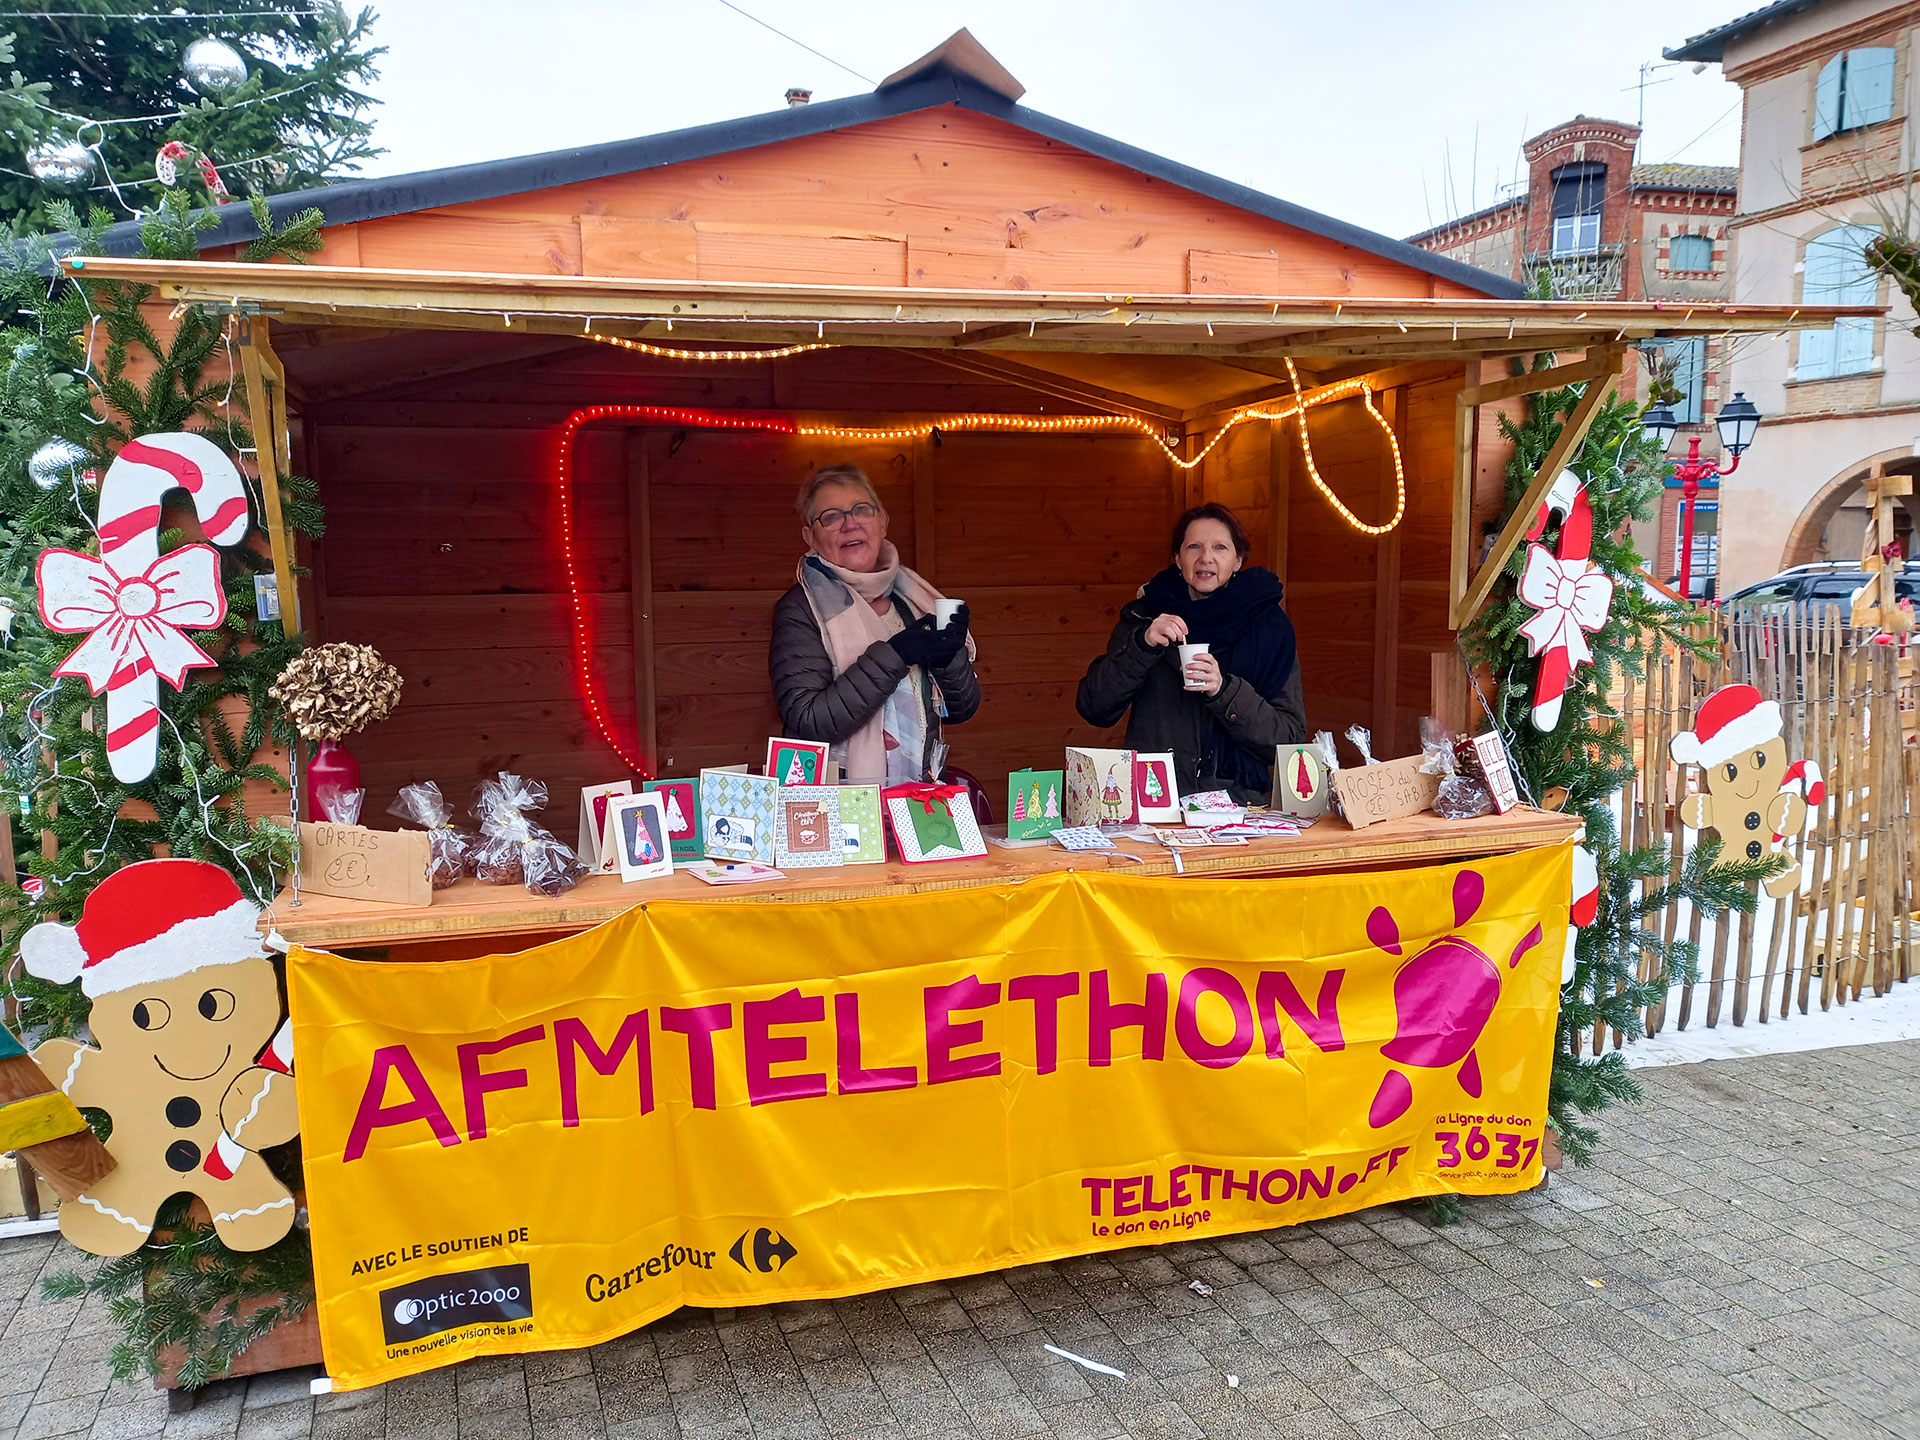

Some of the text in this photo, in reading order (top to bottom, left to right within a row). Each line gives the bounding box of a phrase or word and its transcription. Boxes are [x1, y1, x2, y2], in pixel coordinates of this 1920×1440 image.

[1345, 767, 1395, 806] ROSES
[315, 826, 379, 850] CARTES
[328, 858, 358, 882] 2€
[1486, 1113, 1504, 1124] du
[1506, 1114, 1533, 1127] don
[1114, 1221, 1145, 1236] don
[1148, 1219, 1170, 1231] en
[351, 1227, 529, 1276] AVEC LE SOUTIEN DE
[585, 1243, 717, 1303] Carrefour
[404, 1286, 521, 1321] Optic 2000
[386, 1321, 534, 1360] Une nouvelle vision de la vie
